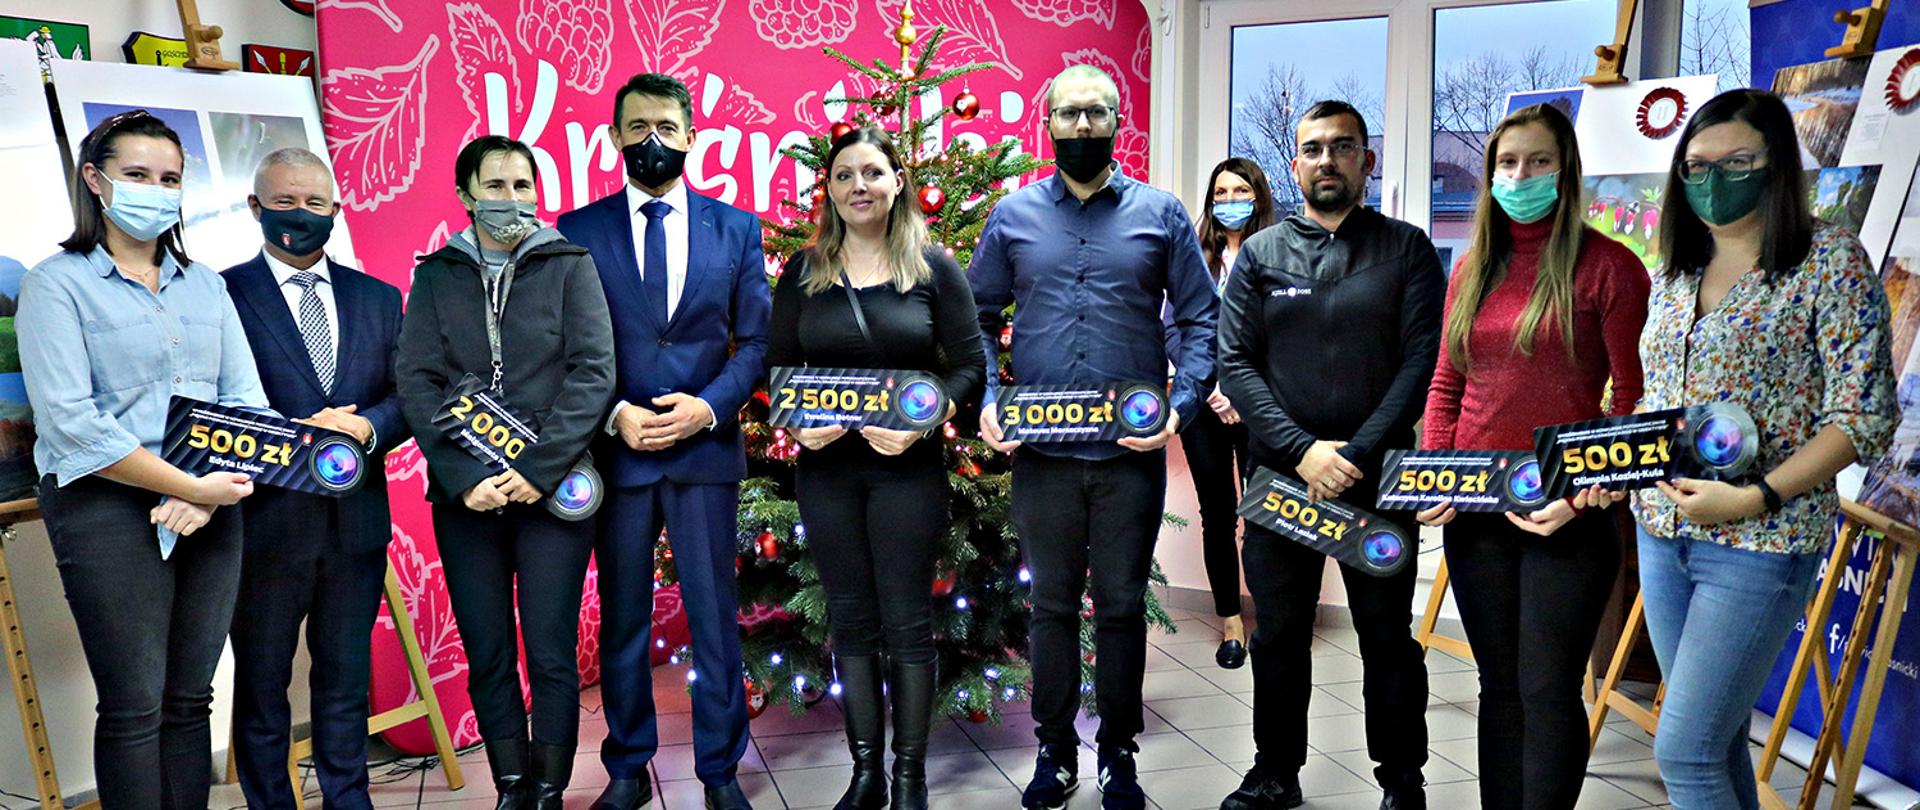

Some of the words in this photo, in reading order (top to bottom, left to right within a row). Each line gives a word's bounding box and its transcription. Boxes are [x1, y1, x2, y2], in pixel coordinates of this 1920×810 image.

[780, 388, 796, 410] 2
[802, 388, 859, 411] 500
[864, 389, 889, 412] zł
[1004, 405, 1020, 425] 3
[1026, 403, 1084, 424] 000
[1089, 401, 1113, 423] zł
[450, 396, 474, 421] 2
[471, 412, 526, 460] 000
[188, 423, 257, 459] 500
[260, 442, 293, 467] zł
[1563, 441, 1633, 475] 500
[1638, 434, 1671, 466] zł
[208, 455, 236, 470] Edyta
[236, 459, 265, 474] Lipiec
[1399, 470, 1457, 492] 500
[1459, 469, 1489, 493] zł
[1572, 473, 1611, 487] Olimpia
[1381, 494, 1419, 503] Katarzyna
[1420, 494, 1452, 502] Karolina
[1262, 491, 1319, 527] 500
[1317, 518, 1349, 541] zł
[1275, 517, 1295, 531] Piotr
